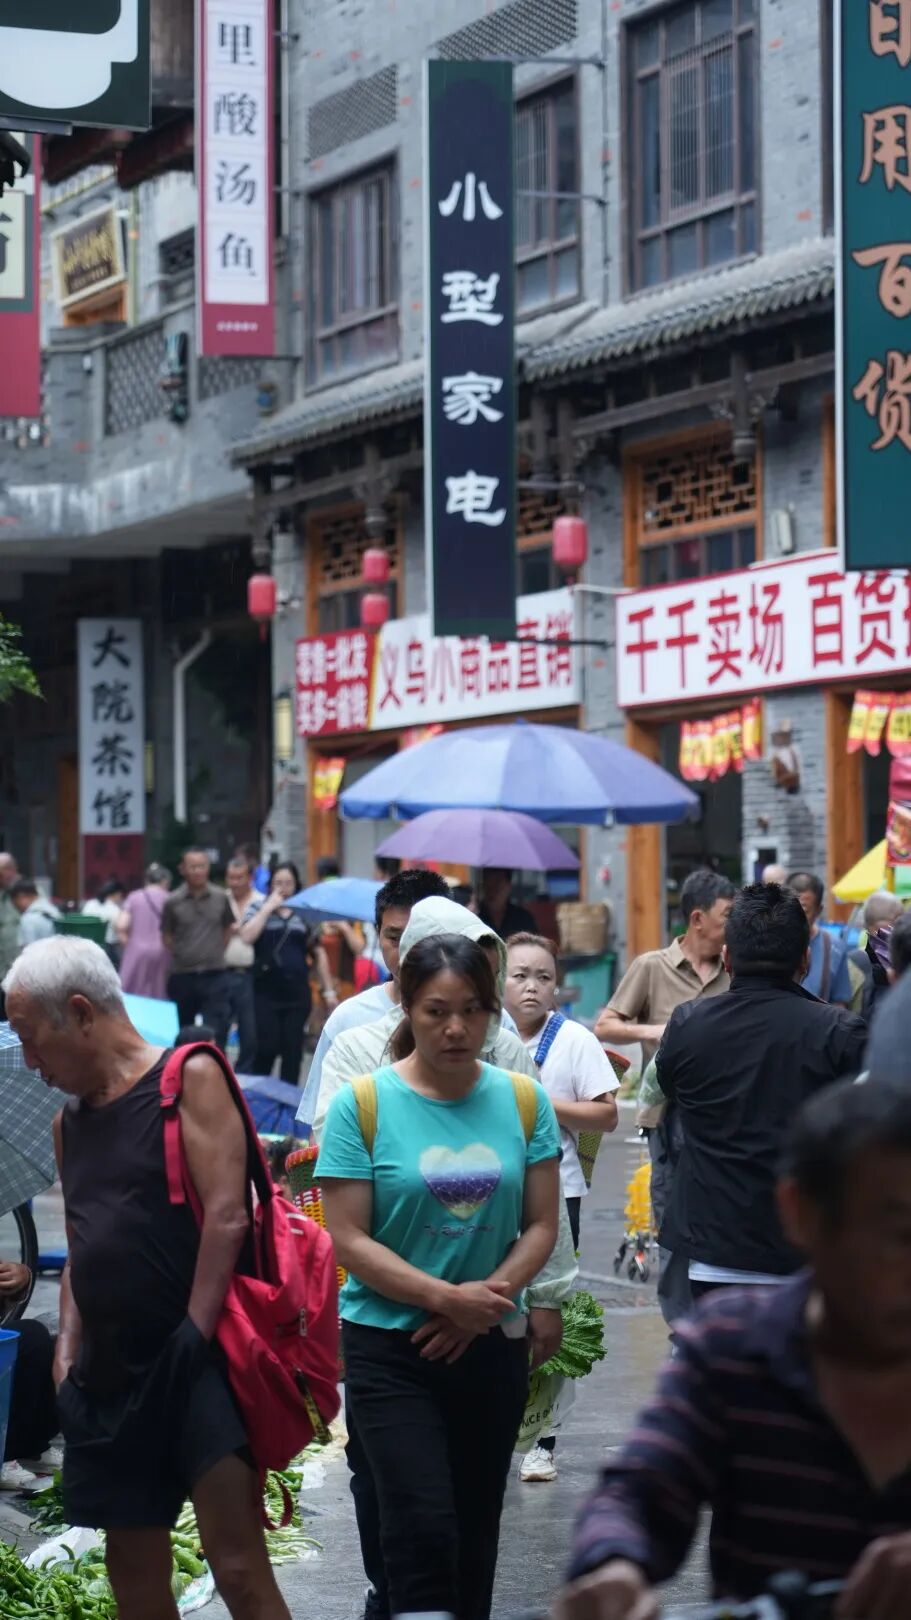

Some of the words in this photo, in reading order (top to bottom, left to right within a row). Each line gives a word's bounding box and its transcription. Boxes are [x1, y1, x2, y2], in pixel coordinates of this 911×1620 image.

[214, 21, 259, 278] 里酸汤鱼
[438, 171, 506, 527] 小型家电
[91, 625, 134, 829] 大院茶馆
[626, 581, 784, 694] 千千卖场
